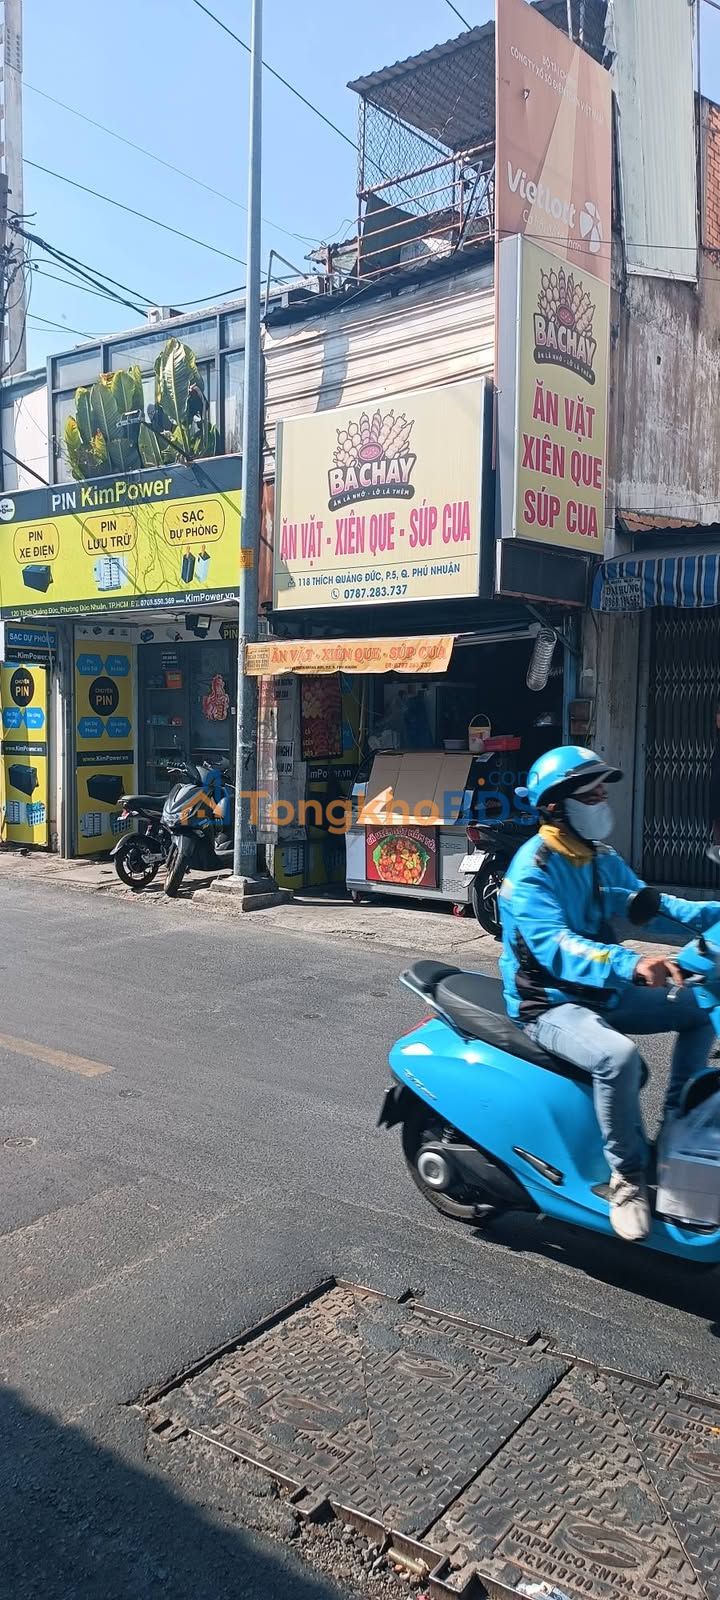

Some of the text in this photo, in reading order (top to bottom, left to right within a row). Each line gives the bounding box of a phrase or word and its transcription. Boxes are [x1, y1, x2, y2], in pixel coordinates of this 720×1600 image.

[508, 161, 576, 228] Vietlott
[533, 379, 595, 443] ĂN VẶT
[522, 433, 602, 490] XIÊN QUE
[52, 478, 172, 512] PIN KimPower
[182, 510, 204, 525] SẠC
[524, 486, 598, 538] SÚP CUA
[101, 520, 117, 532] PIN
[186, 524, 218, 537] PHÒNG
[280, 517, 297, 561] ĂN
[301, 514, 323, 567] VẶT
[335, 509, 365, 556] XIÊN
[369, 512, 395, 557] QUE
[410, 499, 438, 548] SÚP
[442, 501, 471, 544] CUA
[28, 530, 43, 542] PIN
[111, 529, 132, 546] TRỮ
[19, 544, 54, 559] XE ĐIỆN
[298, 578, 311, 587] 118
[312, 574, 334, 586] THÍCH
[335, 572, 363, 584] QUẢNG
[401, 569, 410, 578] Q.
[412, 565, 428, 578] PHÚ
[430, 564, 460, 577] NHUẬN
[344, 584, 407, 600] 0787.283.737
[9, 633, 23, 642] SẠC
[321, 645, 352, 662] XIÊN
[15, 686, 29, 697] PIN
[96, 695, 113, 706] PIN
